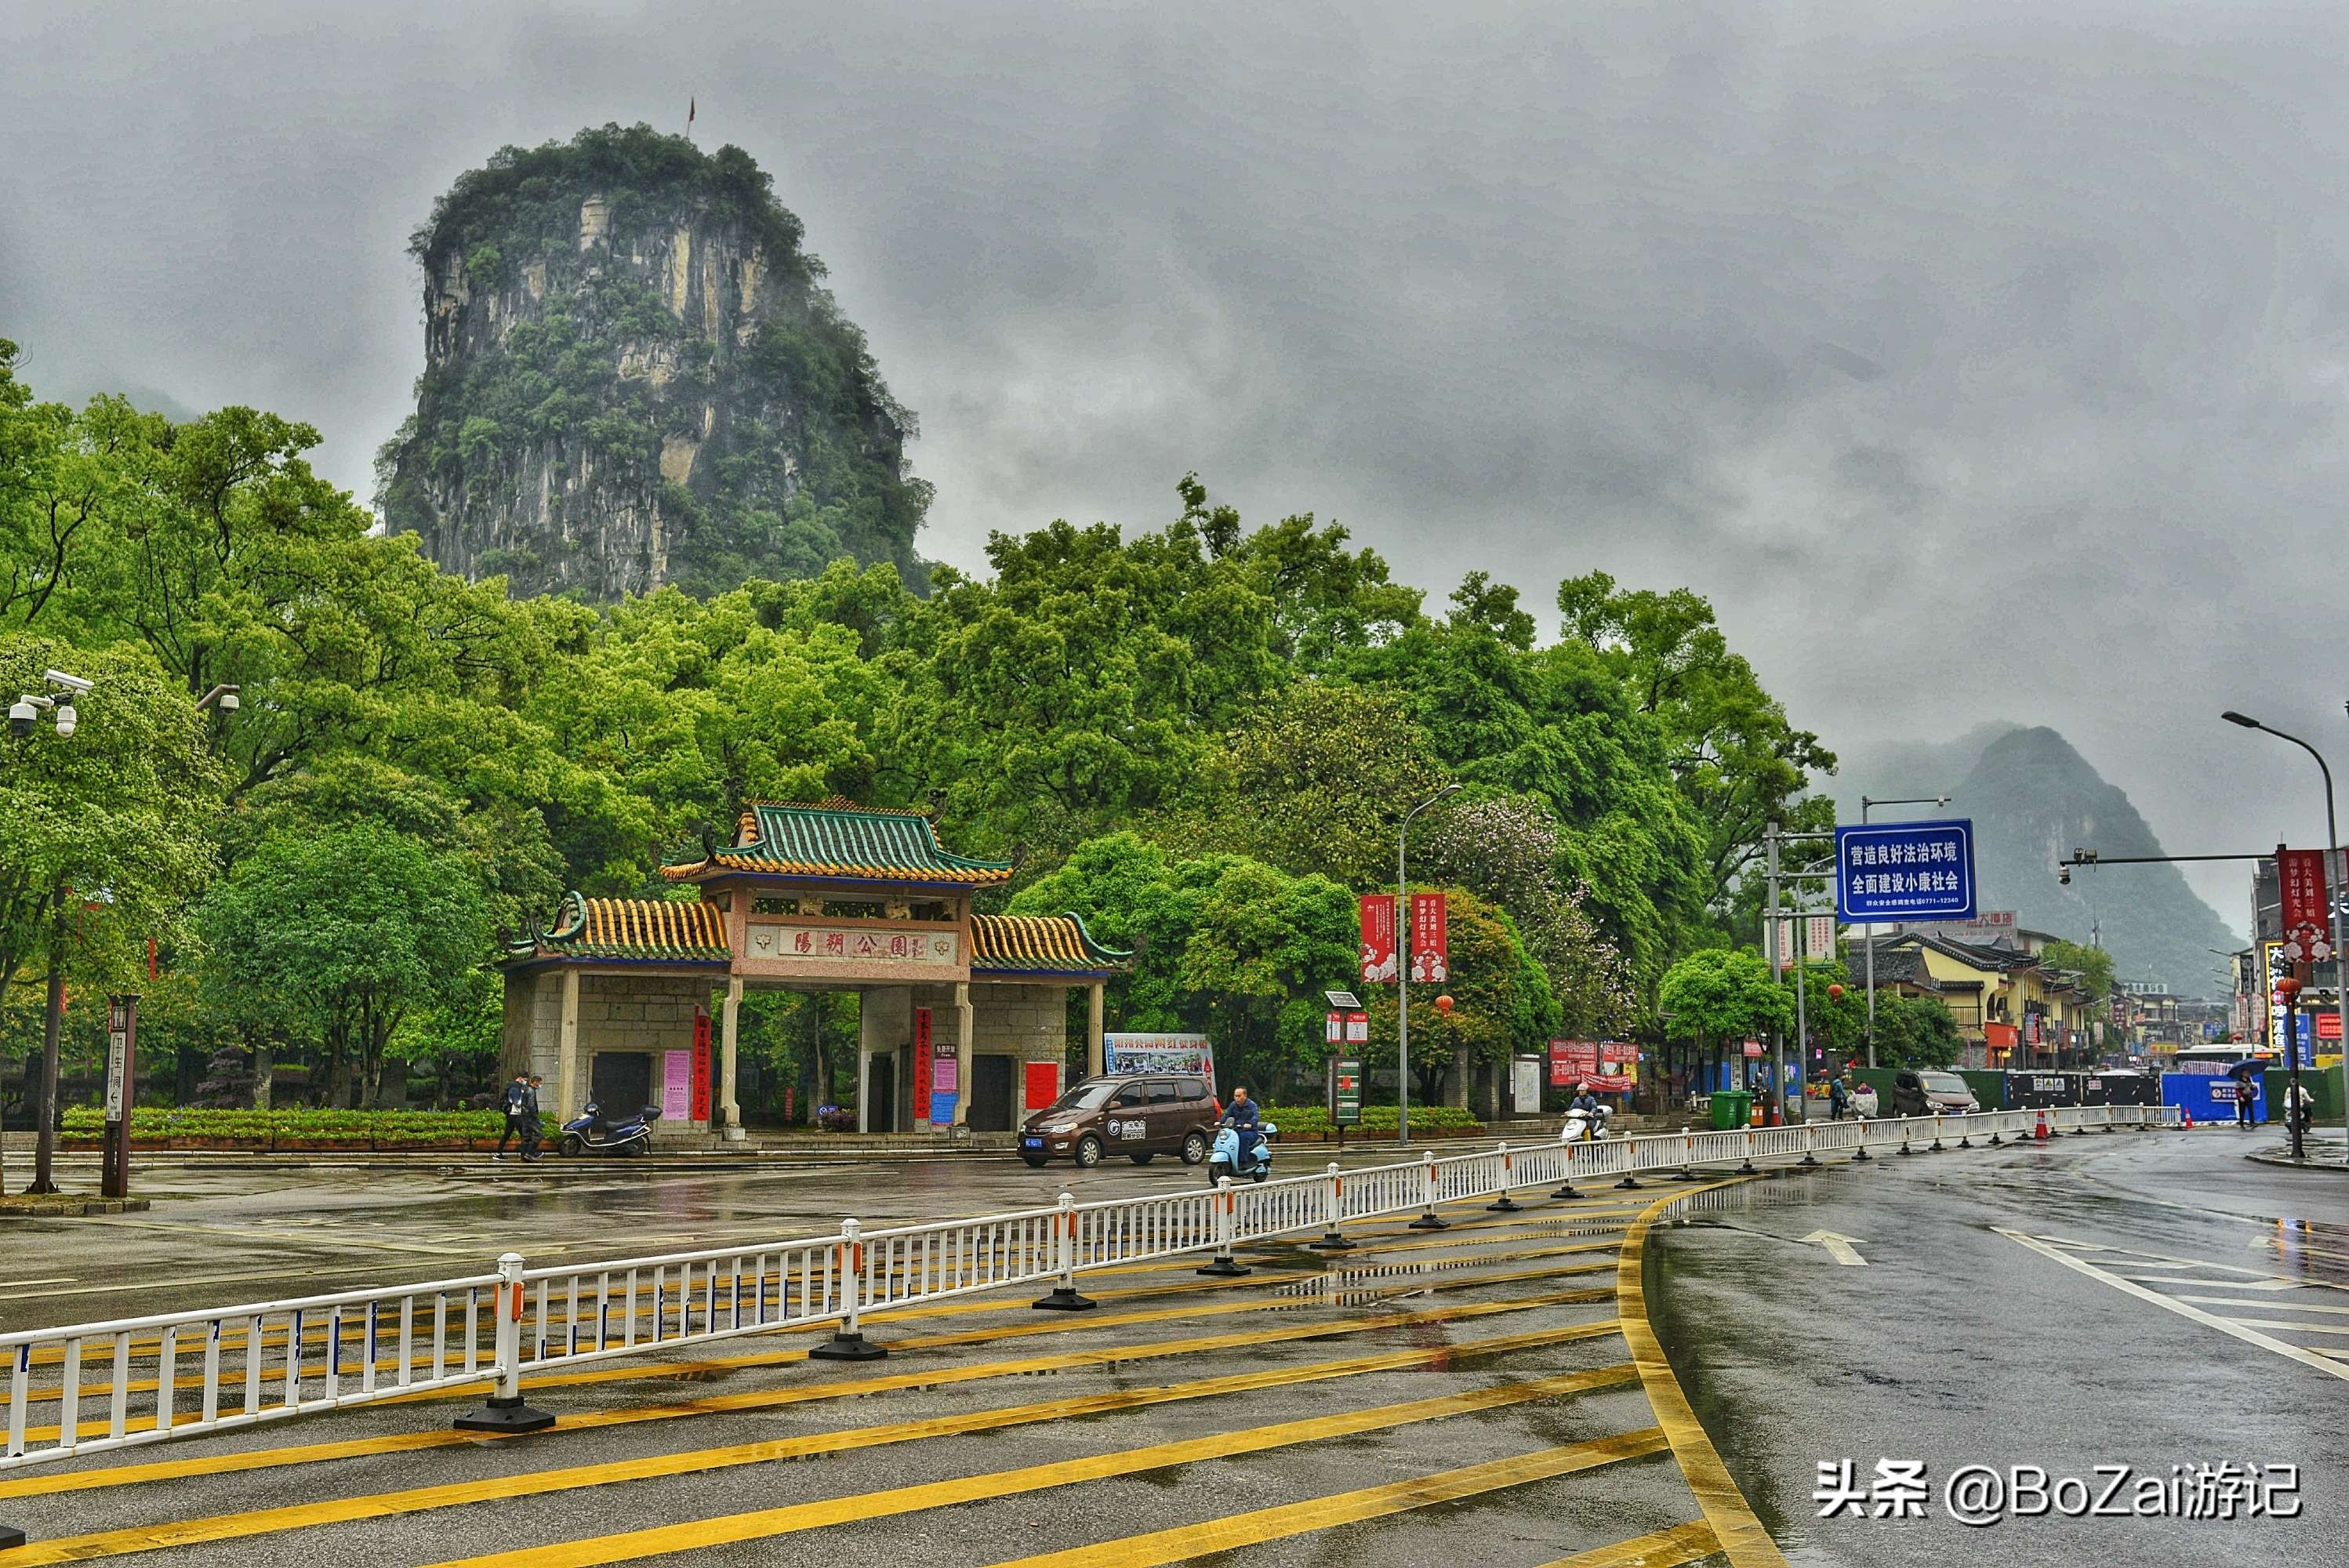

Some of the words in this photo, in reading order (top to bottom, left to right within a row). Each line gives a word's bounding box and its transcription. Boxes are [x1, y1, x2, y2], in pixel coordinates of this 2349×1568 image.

[1851, 841, 1957, 866] 营造良好法治环境
[1852, 870, 1958, 895] 全面建设小康社会
[1866, 897, 1959, 906] 群众安全感调查电话0771-12340
[795, 931, 907, 957] 陽朔公園
[113, 1037, 122, 1088] 卫生间
